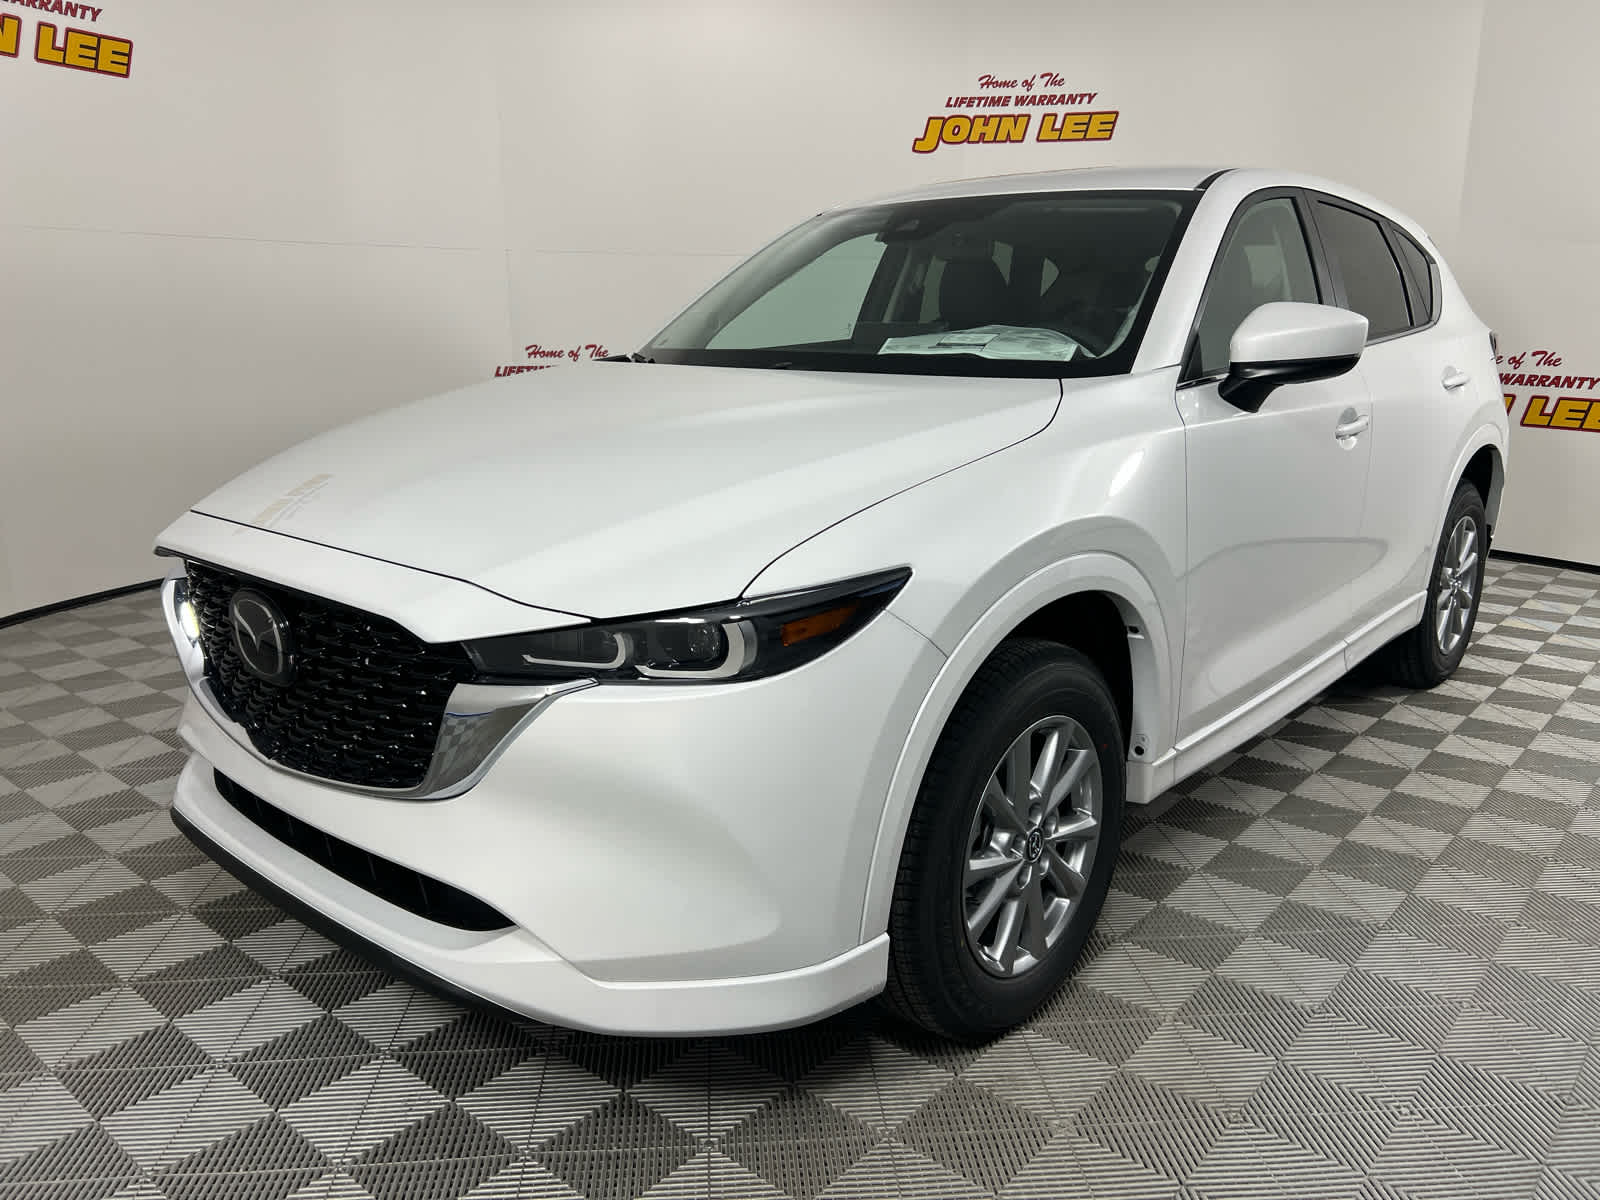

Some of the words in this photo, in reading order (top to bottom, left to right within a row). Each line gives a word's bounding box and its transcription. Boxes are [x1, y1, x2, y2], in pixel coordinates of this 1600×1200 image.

[0, 0, 102, 22] RRANTY
[34, 21, 134, 79] LEE
[977, 73, 1018, 89] Home
[1021, 74, 1036, 92] of
[1040, 72, 1065, 88] The
[945, 95, 1012, 108] LIFETIME
[1014, 92, 1098, 107] WARRANTY
[911, 114, 1031, 154] JOHN
[1036, 110, 1119, 143] LEE
[525, 344, 564, 359] Home
[567, 346, 582, 362] of
[585, 344, 609, 359] The
[1507, 351, 1527, 370] of
[1531, 350, 1563, 367] The
[494, 364, 560, 377] LIFET
[1498, 372, 1600, 390] WARRANTY
